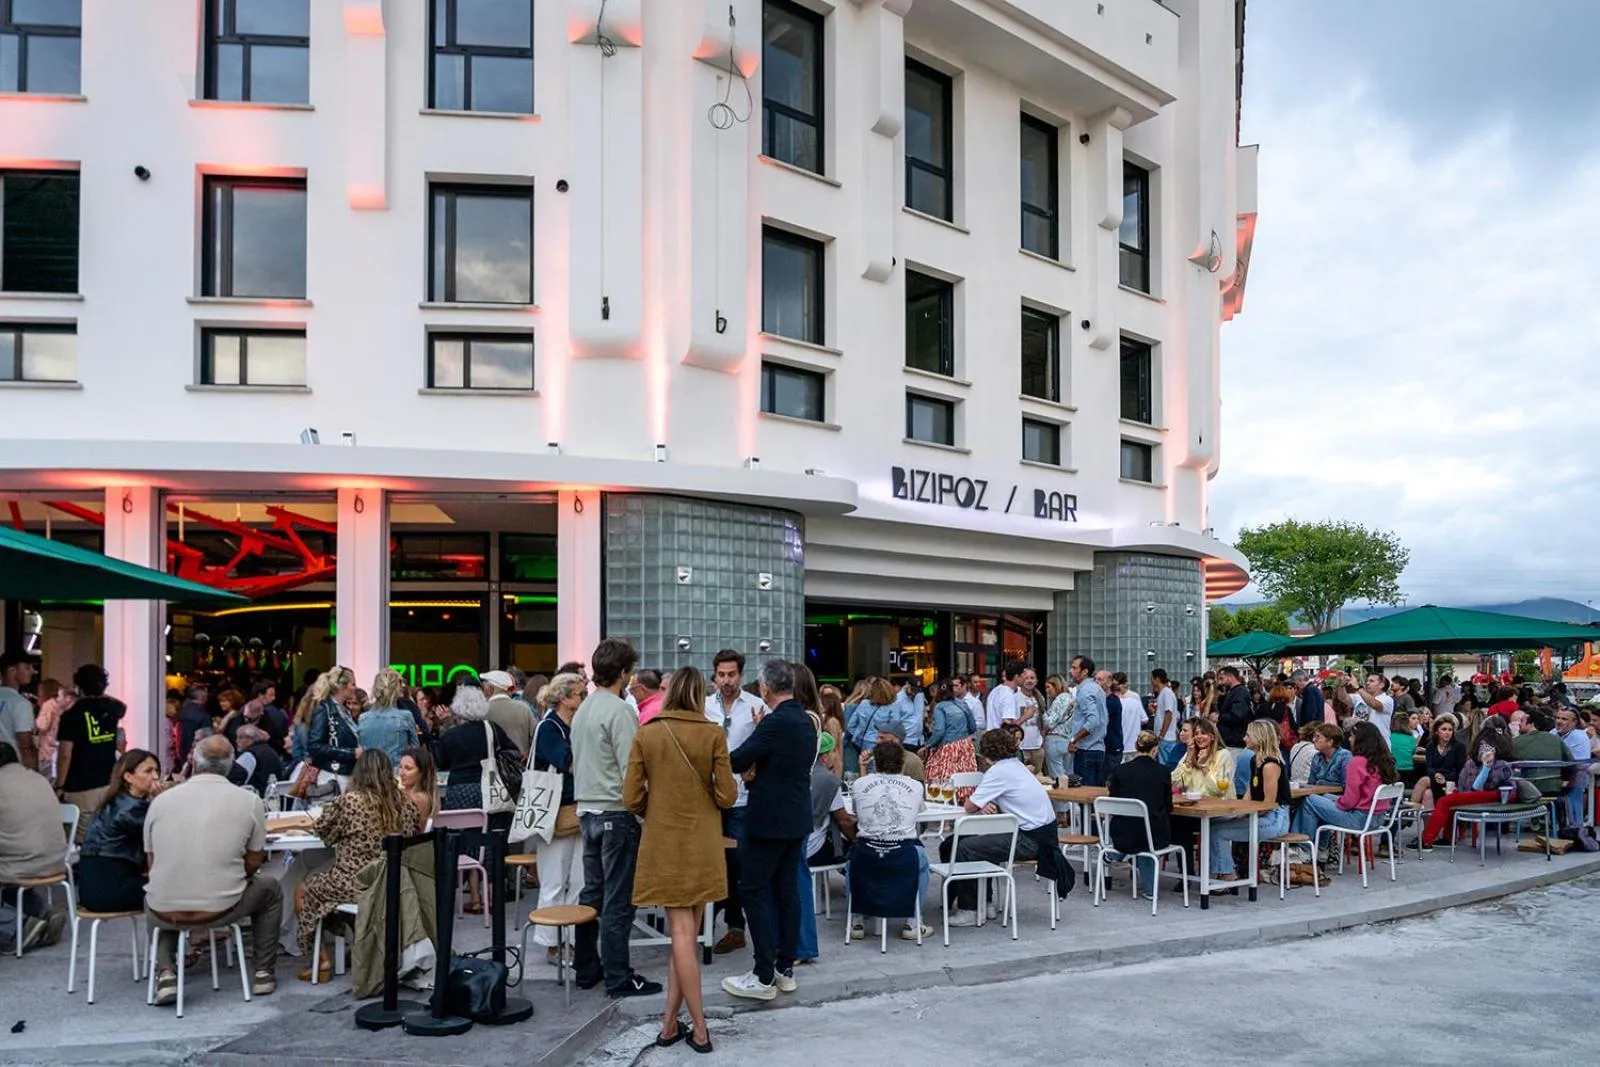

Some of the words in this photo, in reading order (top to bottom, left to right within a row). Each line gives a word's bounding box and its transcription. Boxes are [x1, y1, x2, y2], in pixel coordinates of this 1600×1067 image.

[891, 466, 989, 511] BIZIPOZ
[1033, 488, 1078, 522] BAR
[514, 808, 549, 830] POZ
